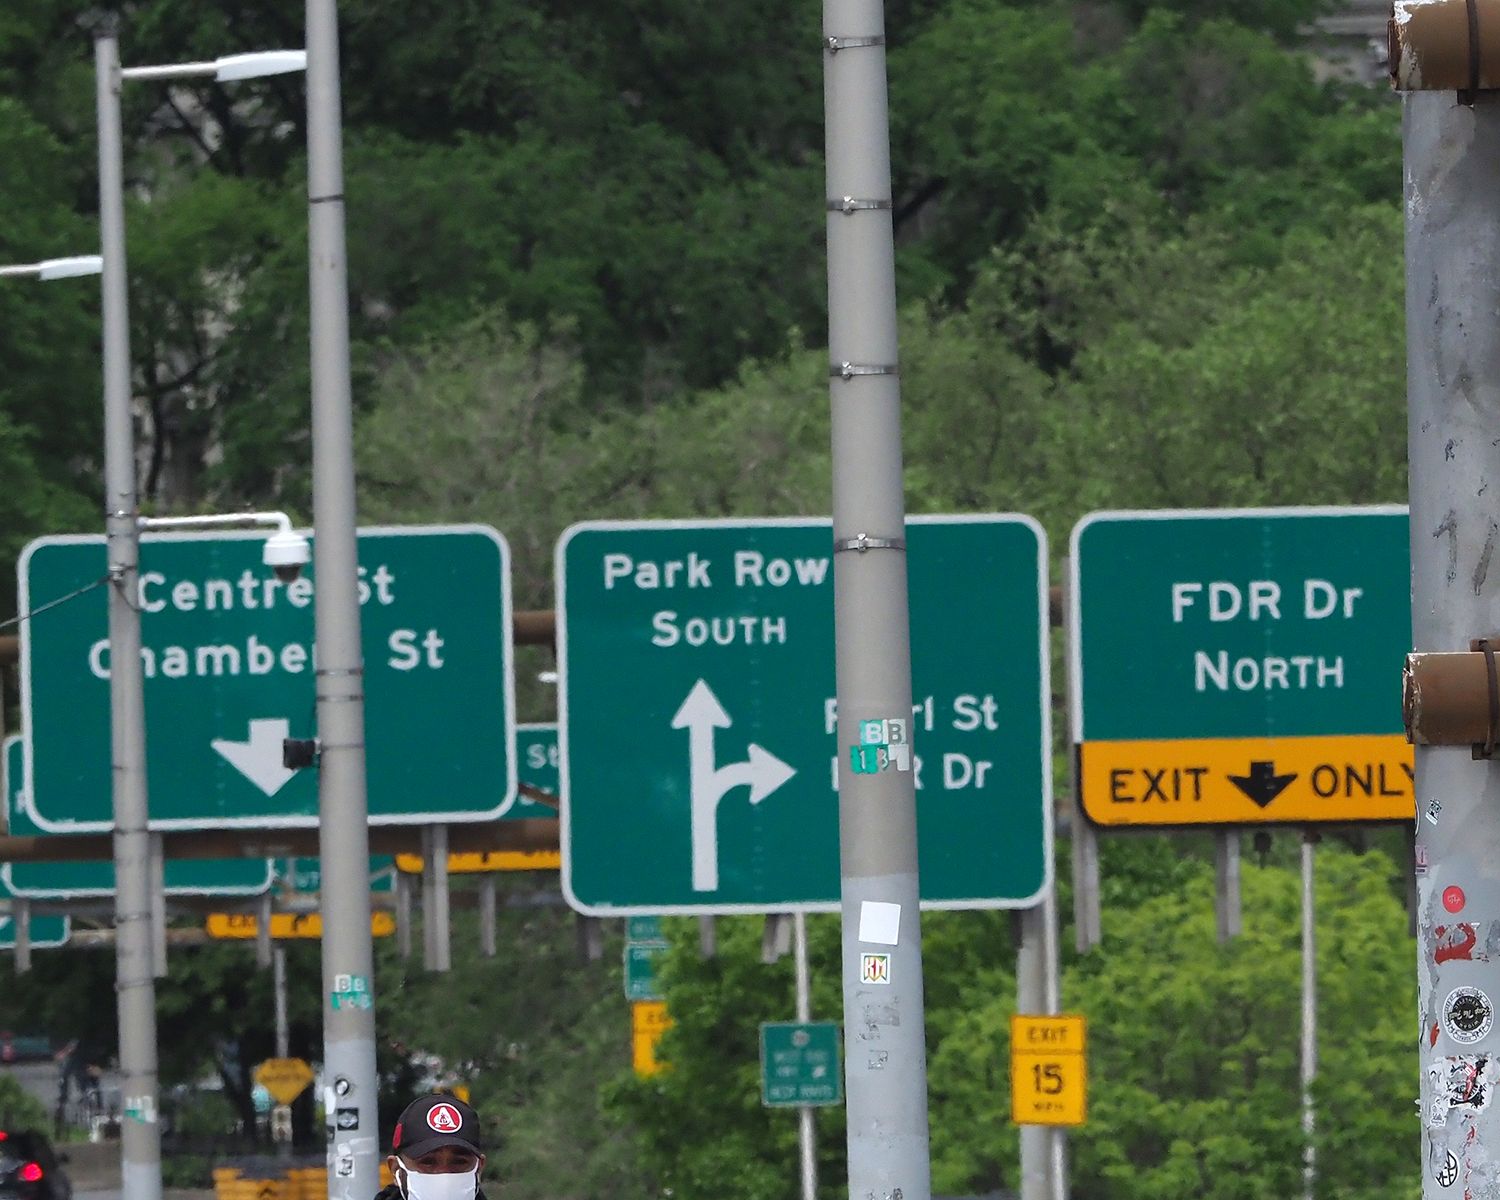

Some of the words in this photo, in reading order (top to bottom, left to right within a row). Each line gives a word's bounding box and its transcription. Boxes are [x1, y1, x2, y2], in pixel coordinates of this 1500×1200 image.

[604, 553, 711, 590] Park
[735, 551, 830, 587] Row
[138, 570, 314, 613] Centre
[1172, 581, 1281, 622] FDR
[1305, 579, 1362, 620] Dr
[652, 611, 786, 647] SOUTH
[388, 629, 445, 671] St
[1195, 651, 1344, 691] NORTH
[953, 694, 999, 731] St
[943, 752, 993, 790] Dr
[1111, 767, 1208, 802] EXIT
[1033, 1063, 1064, 1095] 15
